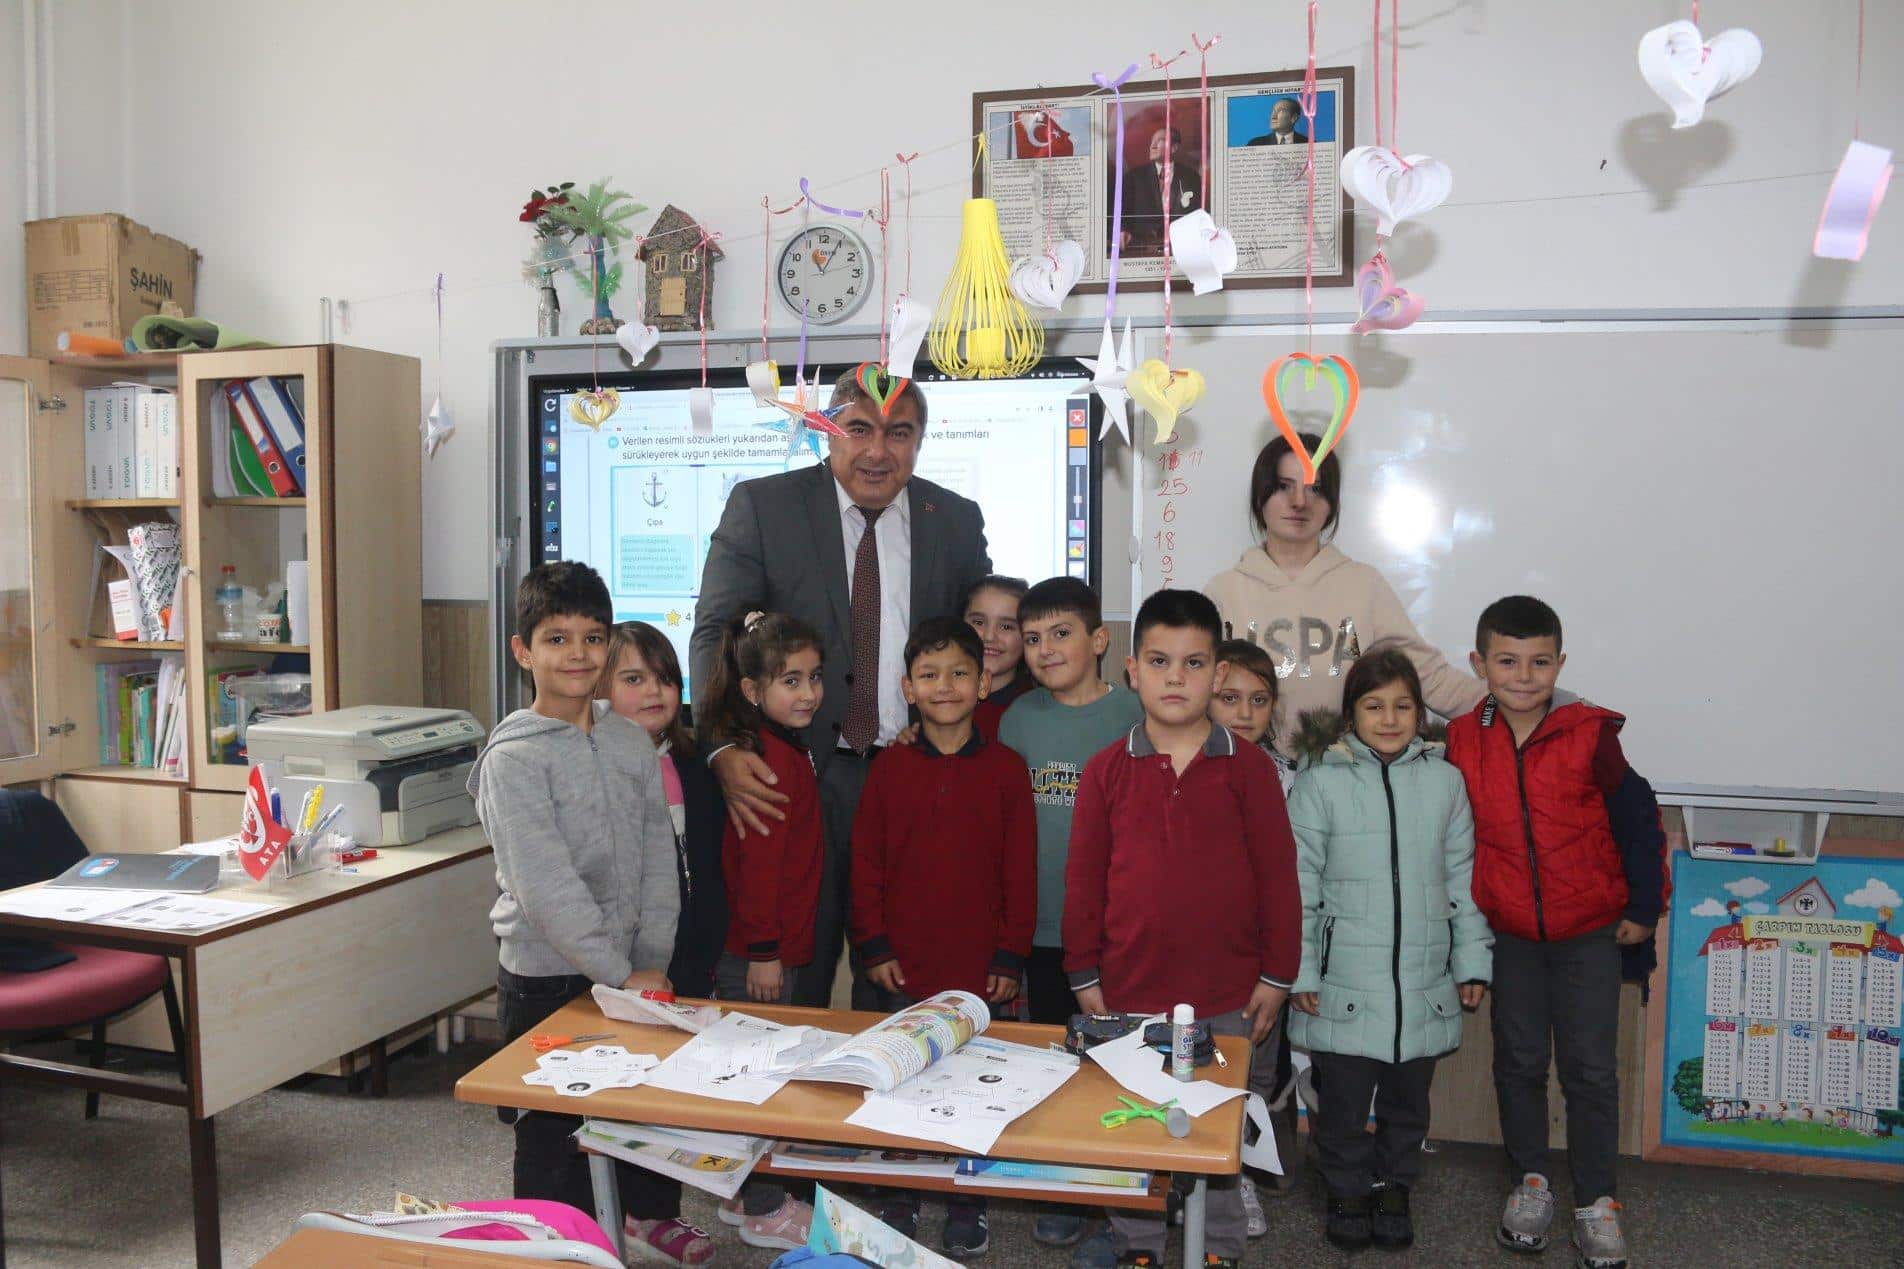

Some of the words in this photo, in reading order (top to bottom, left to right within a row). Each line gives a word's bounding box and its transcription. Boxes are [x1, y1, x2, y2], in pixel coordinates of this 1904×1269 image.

[818, 234, 830, 244] 12
[792, 252, 802, 263] 10
[847, 252, 856, 262] 2
[786, 269, 796, 279] 9
[852, 268, 861, 279] 3
[130, 267, 173, 300] ŞAHİN
[790, 286, 800, 296] 8
[846, 286, 855, 296] 4
[818, 303, 827, 313] 6
[834, 298, 844, 308] 5
[931, 431, 944, 439] ve
[946, 428, 990, 439] tanımları
[622, 435, 653, 446] Verilen
[656, 435, 684, 445] resimli
[687, 433, 731, 444] sözlükleri
[733, 433, 779, 445] yukarıdan
[622, 450, 679, 461] sürükleyerek
[682, 450, 710, 460] uygun
[712, 448, 745, 459] şekilde
[1158, 478, 1189, 496] 25
[1163, 501, 1176, 522] 6
[1154, 531, 1175, 550] 18
[1161, 555, 1173, 573] 9
[685, 612, 692, 621] 4
[259, 840, 281, 866] ATA
